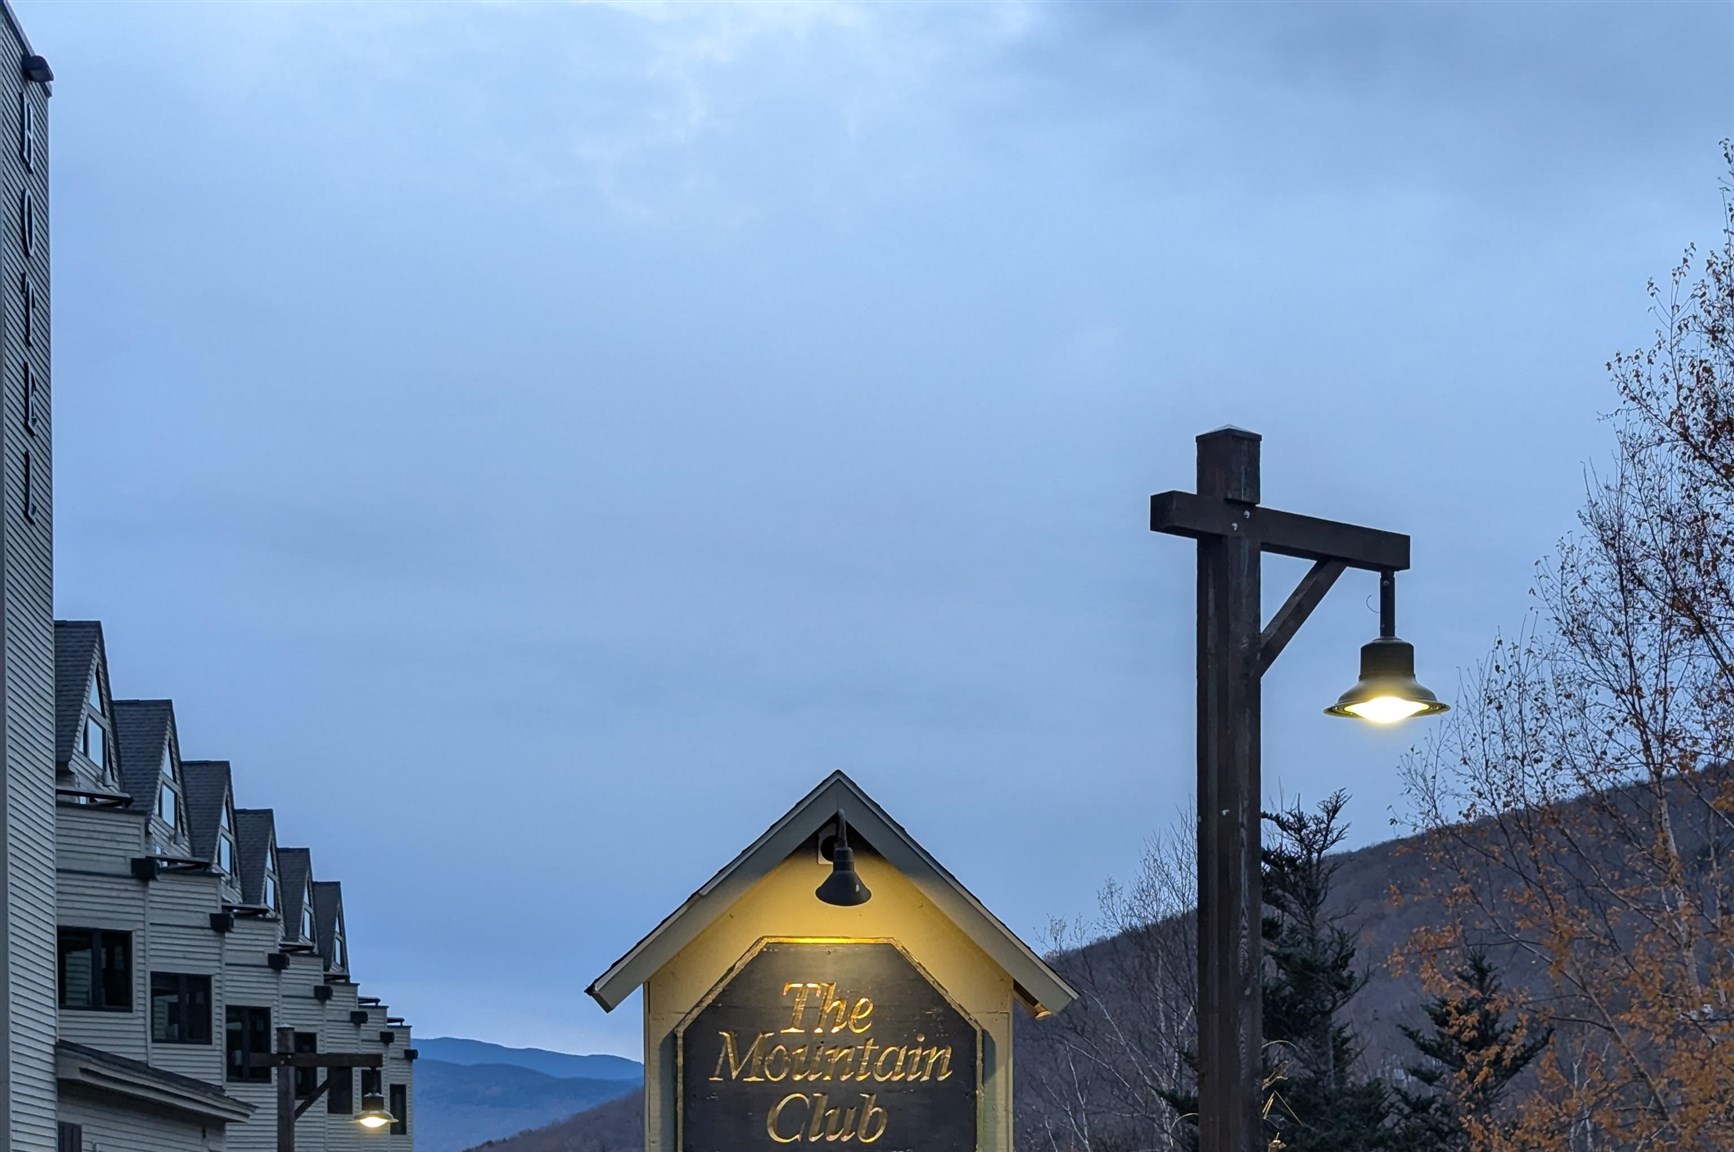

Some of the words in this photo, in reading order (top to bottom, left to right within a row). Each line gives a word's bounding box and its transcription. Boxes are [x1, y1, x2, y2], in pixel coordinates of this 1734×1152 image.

[20, 91, 37, 525] HOTEL
[780, 982, 874, 1034] The
[708, 1031, 953, 1083] Mountain
[766, 1092, 888, 1143] Club
